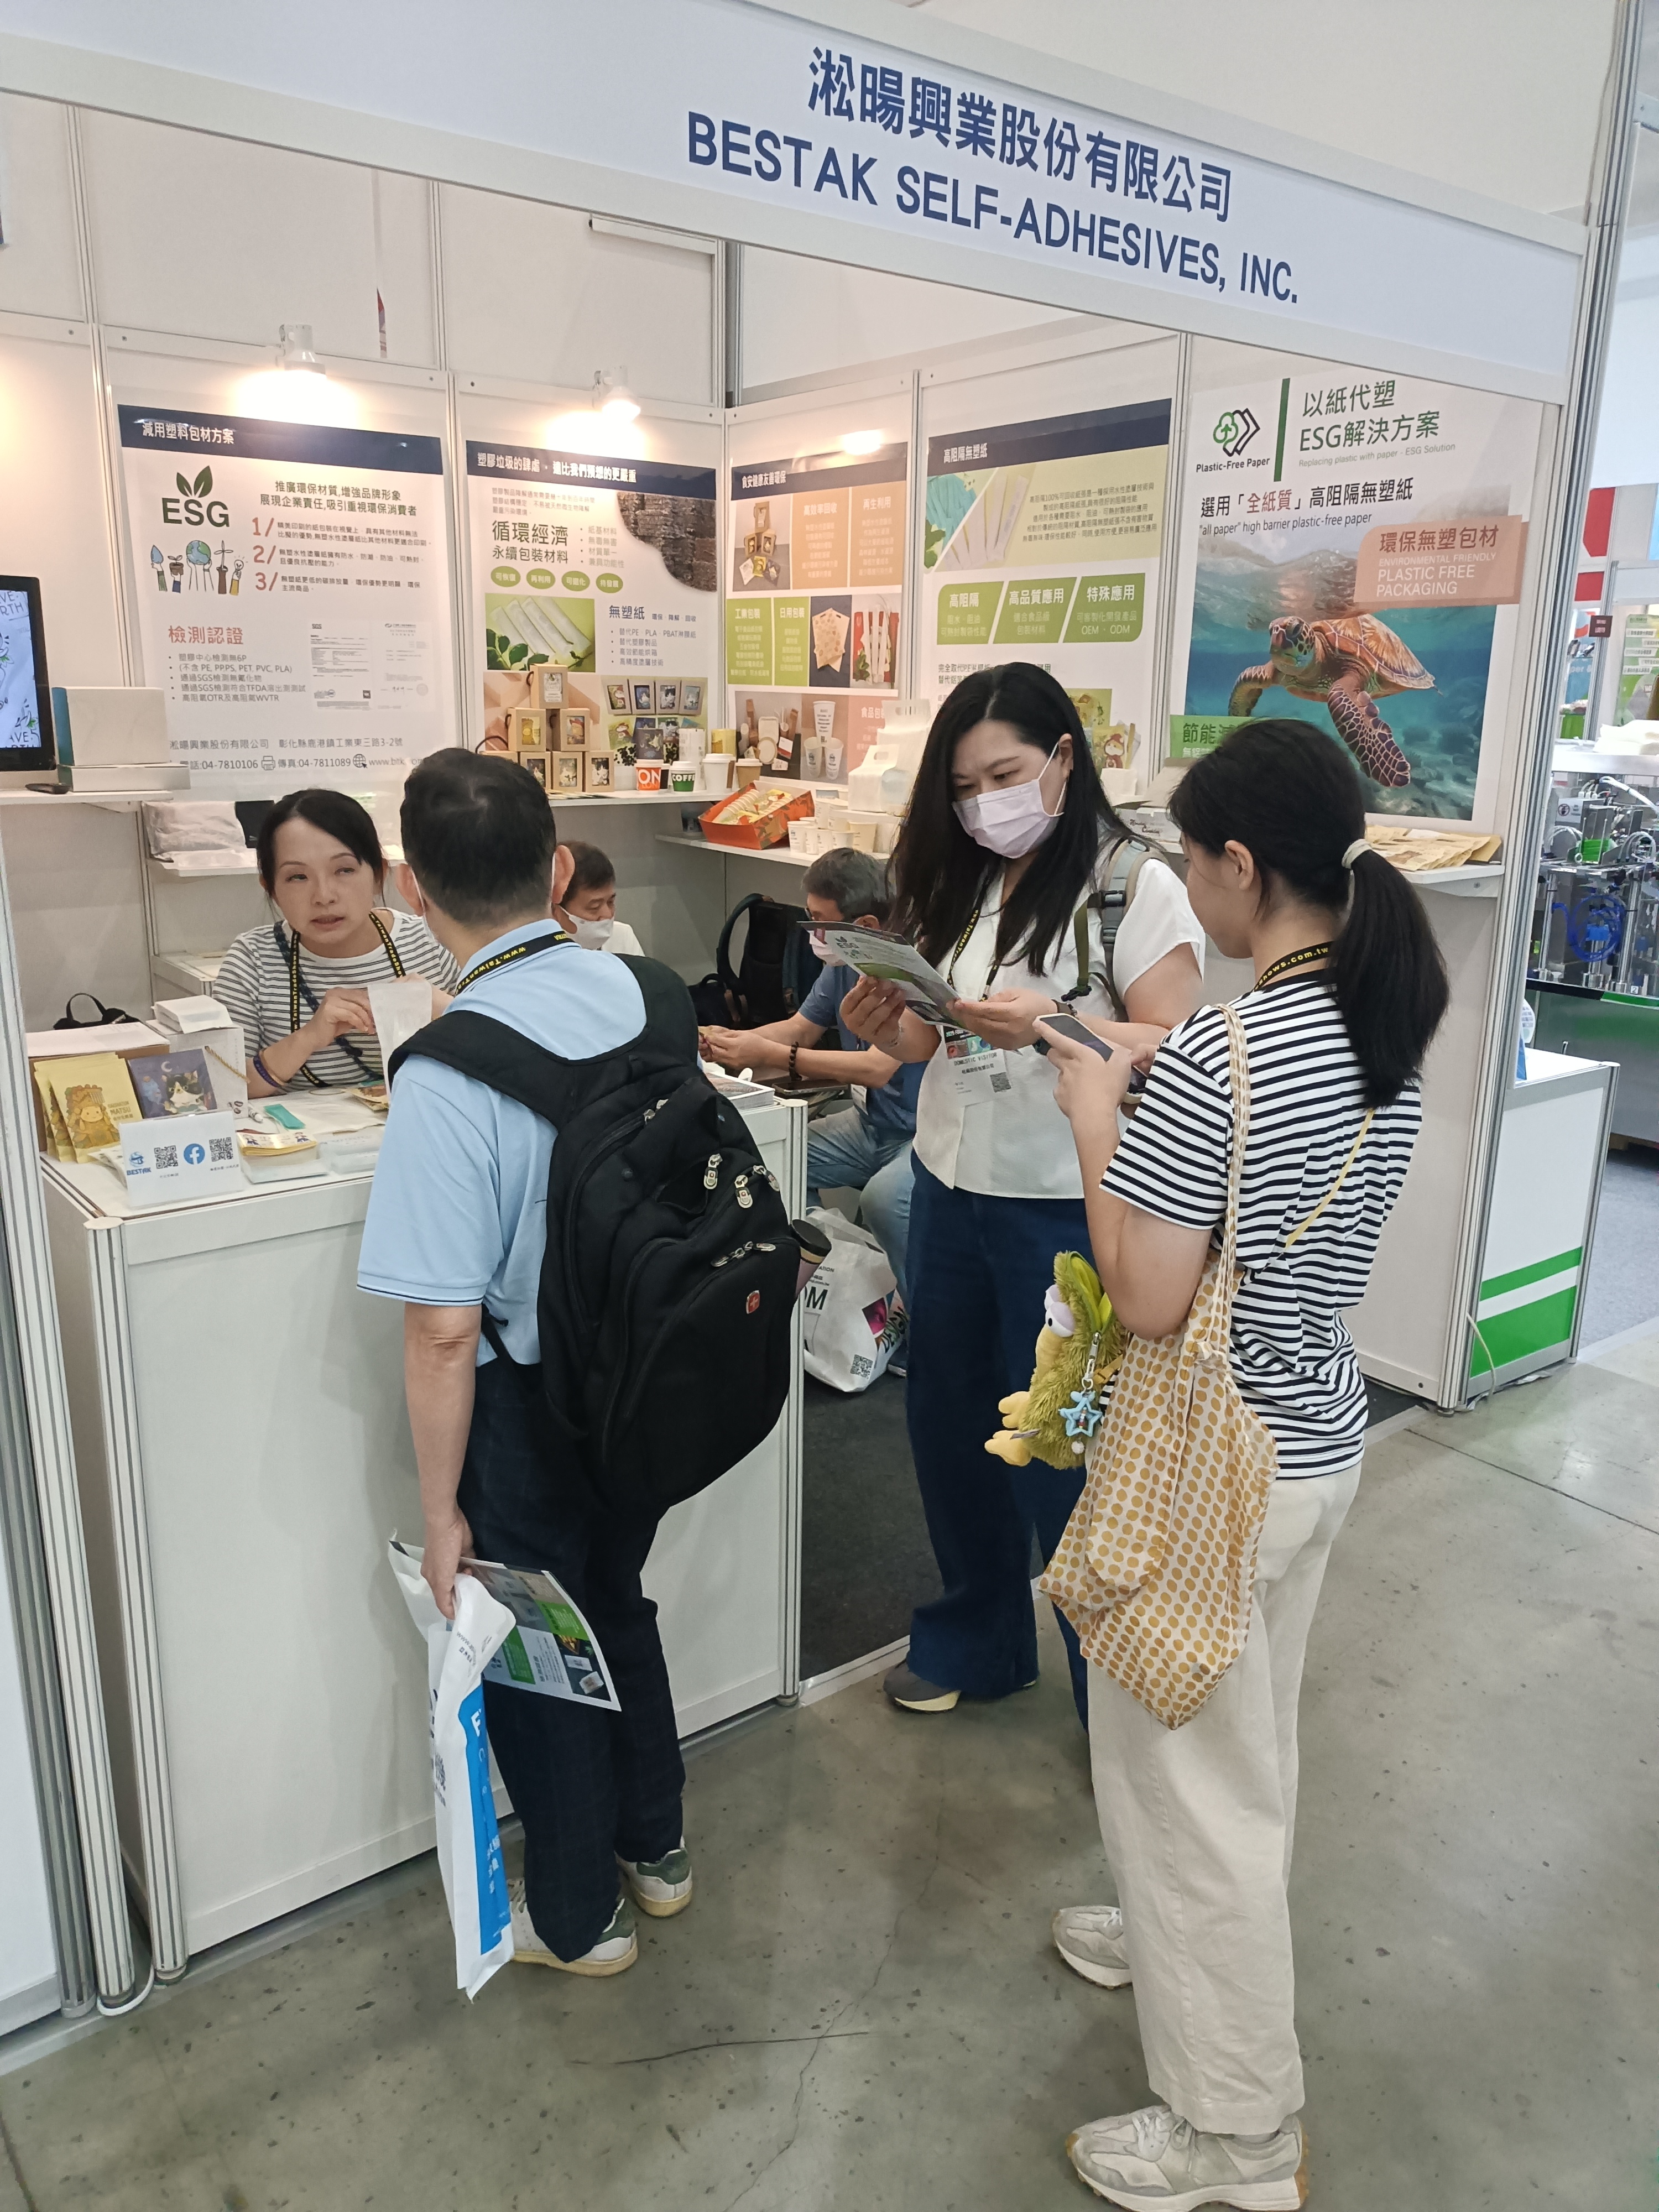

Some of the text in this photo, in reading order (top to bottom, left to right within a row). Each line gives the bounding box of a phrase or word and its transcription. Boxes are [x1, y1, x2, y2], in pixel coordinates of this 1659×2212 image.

[808, 47, 1232, 223] 淞暘興業股份有限公司
[688, 112, 1298, 304] BESTAK SELF-ADHESIVES, INC.
[1303, 380, 1396, 418] 以紙代塑
[142, 421, 235, 445] 減用塑料包材方案
[1300, 410, 1440, 451] ESG解決方案
[943, 442, 988, 463] 高阻隔無塑紙
[1299, 457, 1333, 468] Replacing
[1334, 455, 1358, 465] plastic
[1359, 453, 1375, 461] with
[1377, 451, 1398, 460] paper
[1405, 447, 1422, 456] ESG
[1424, 444, 1455, 453] Solution
[1196, 457, 1270, 472] Plastic-Free Paper
[275, 480, 401, 501] 推廣環保材質,增強品牌形象
[1201, 477, 1413, 518] 選用「全紙質」高阻隔無塑紙
[161, 497, 229, 528] ESG
[492, 520, 568, 547] 循環經濟
[1243, 521, 1260, 534] high
[1263, 519, 1290, 531] barrier
[1292, 514, 1342, 530] plastic-free
[1344, 513, 1372, 527] paper
[1379, 525, 1499, 554] 環保無塑包材
[492, 546, 568, 564] 永續包裝材料
[1379, 552, 1496, 567] ENVIRONMENTAL FRIENDLY
[1378, 564, 1475, 582] PLASTIC FREE
[950, 585, 1135, 608] 高阻隔 高品質應用 特殊應用
[1376, 581, 1458, 597] PACKAGING
[609, 605, 645, 620] 無塑紙
[168, 625, 243, 645] 檢測認證
[170, 738, 269, 750] 淞暘興業股份有限公司
[954, 1052, 998, 1066] DOMESTIC VISITOR
[109, 1107, 131, 1115] MATSU
[127, 1167, 152, 1176] BESTAK
